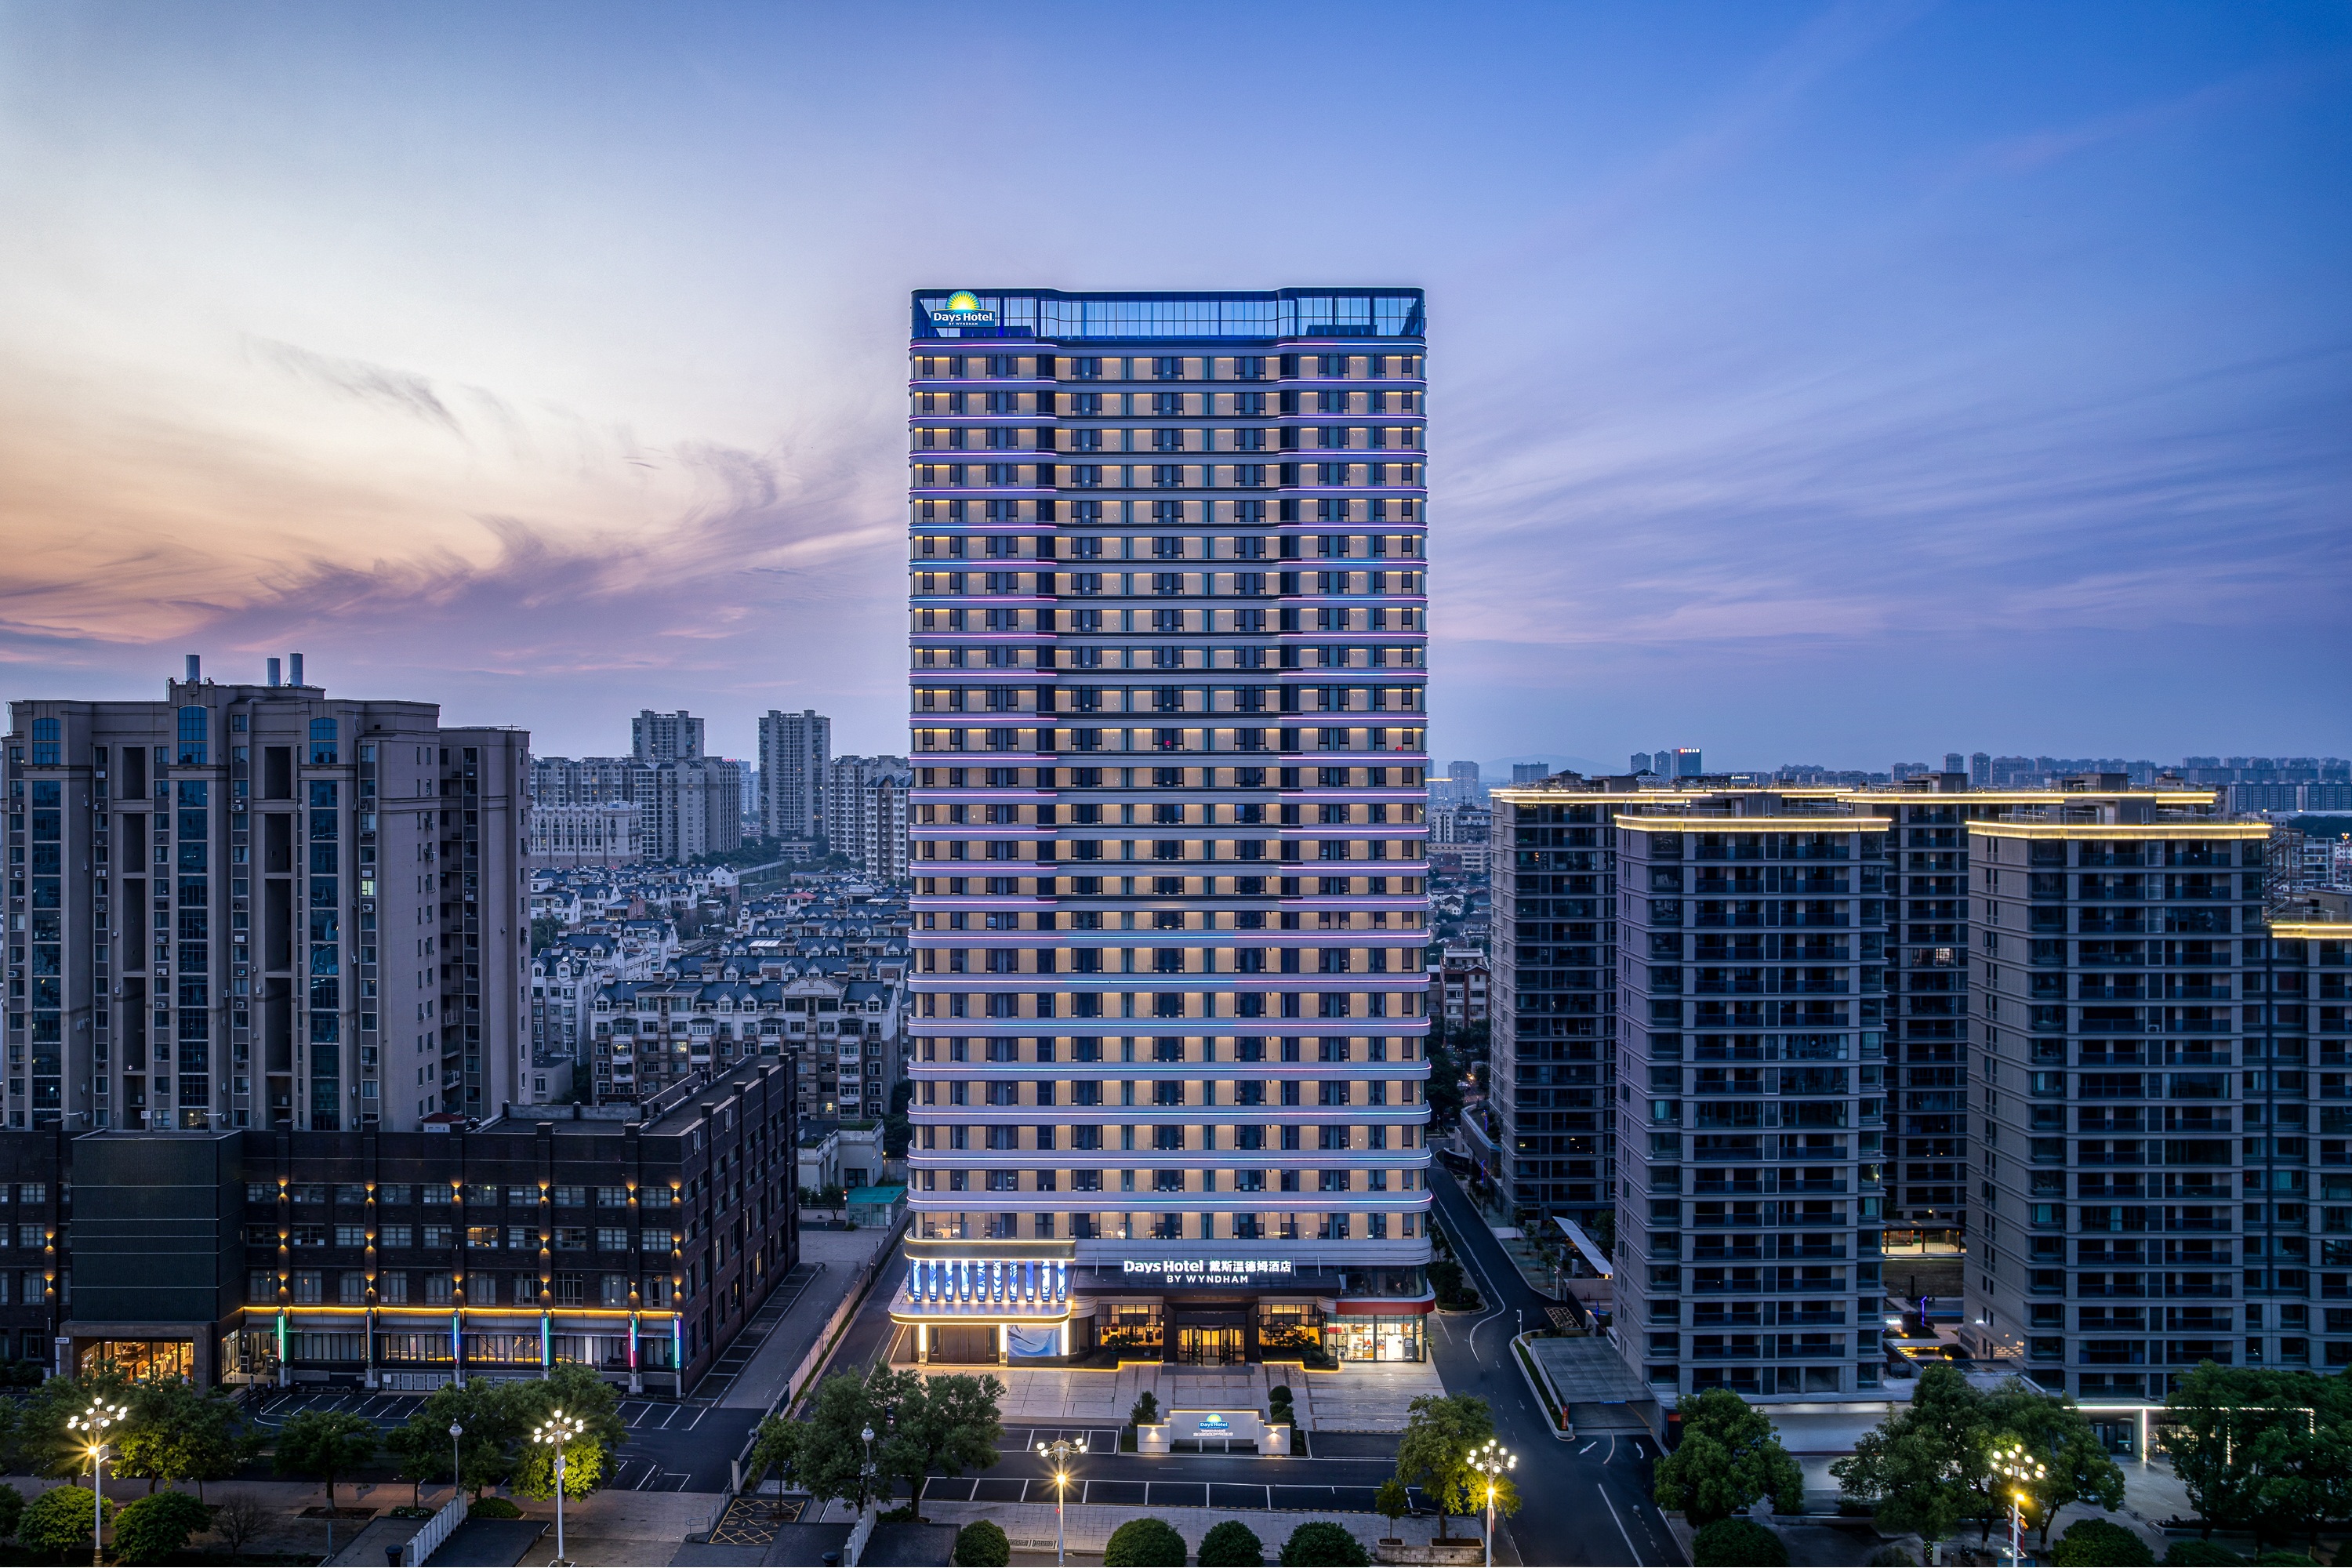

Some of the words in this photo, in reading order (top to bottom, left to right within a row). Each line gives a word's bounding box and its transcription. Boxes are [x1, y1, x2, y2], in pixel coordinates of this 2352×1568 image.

[933, 313, 961, 322] Days
[1123, 1260, 1161, 1274] Days
[1163, 1259, 1204, 1273] Hotel
[1209, 1260, 1292, 1273] 戴斯温德姆酒店
[1167, 1275, 1182, 1283] BY
[1186, 1275, 1249, 1283] WYNDHAM
